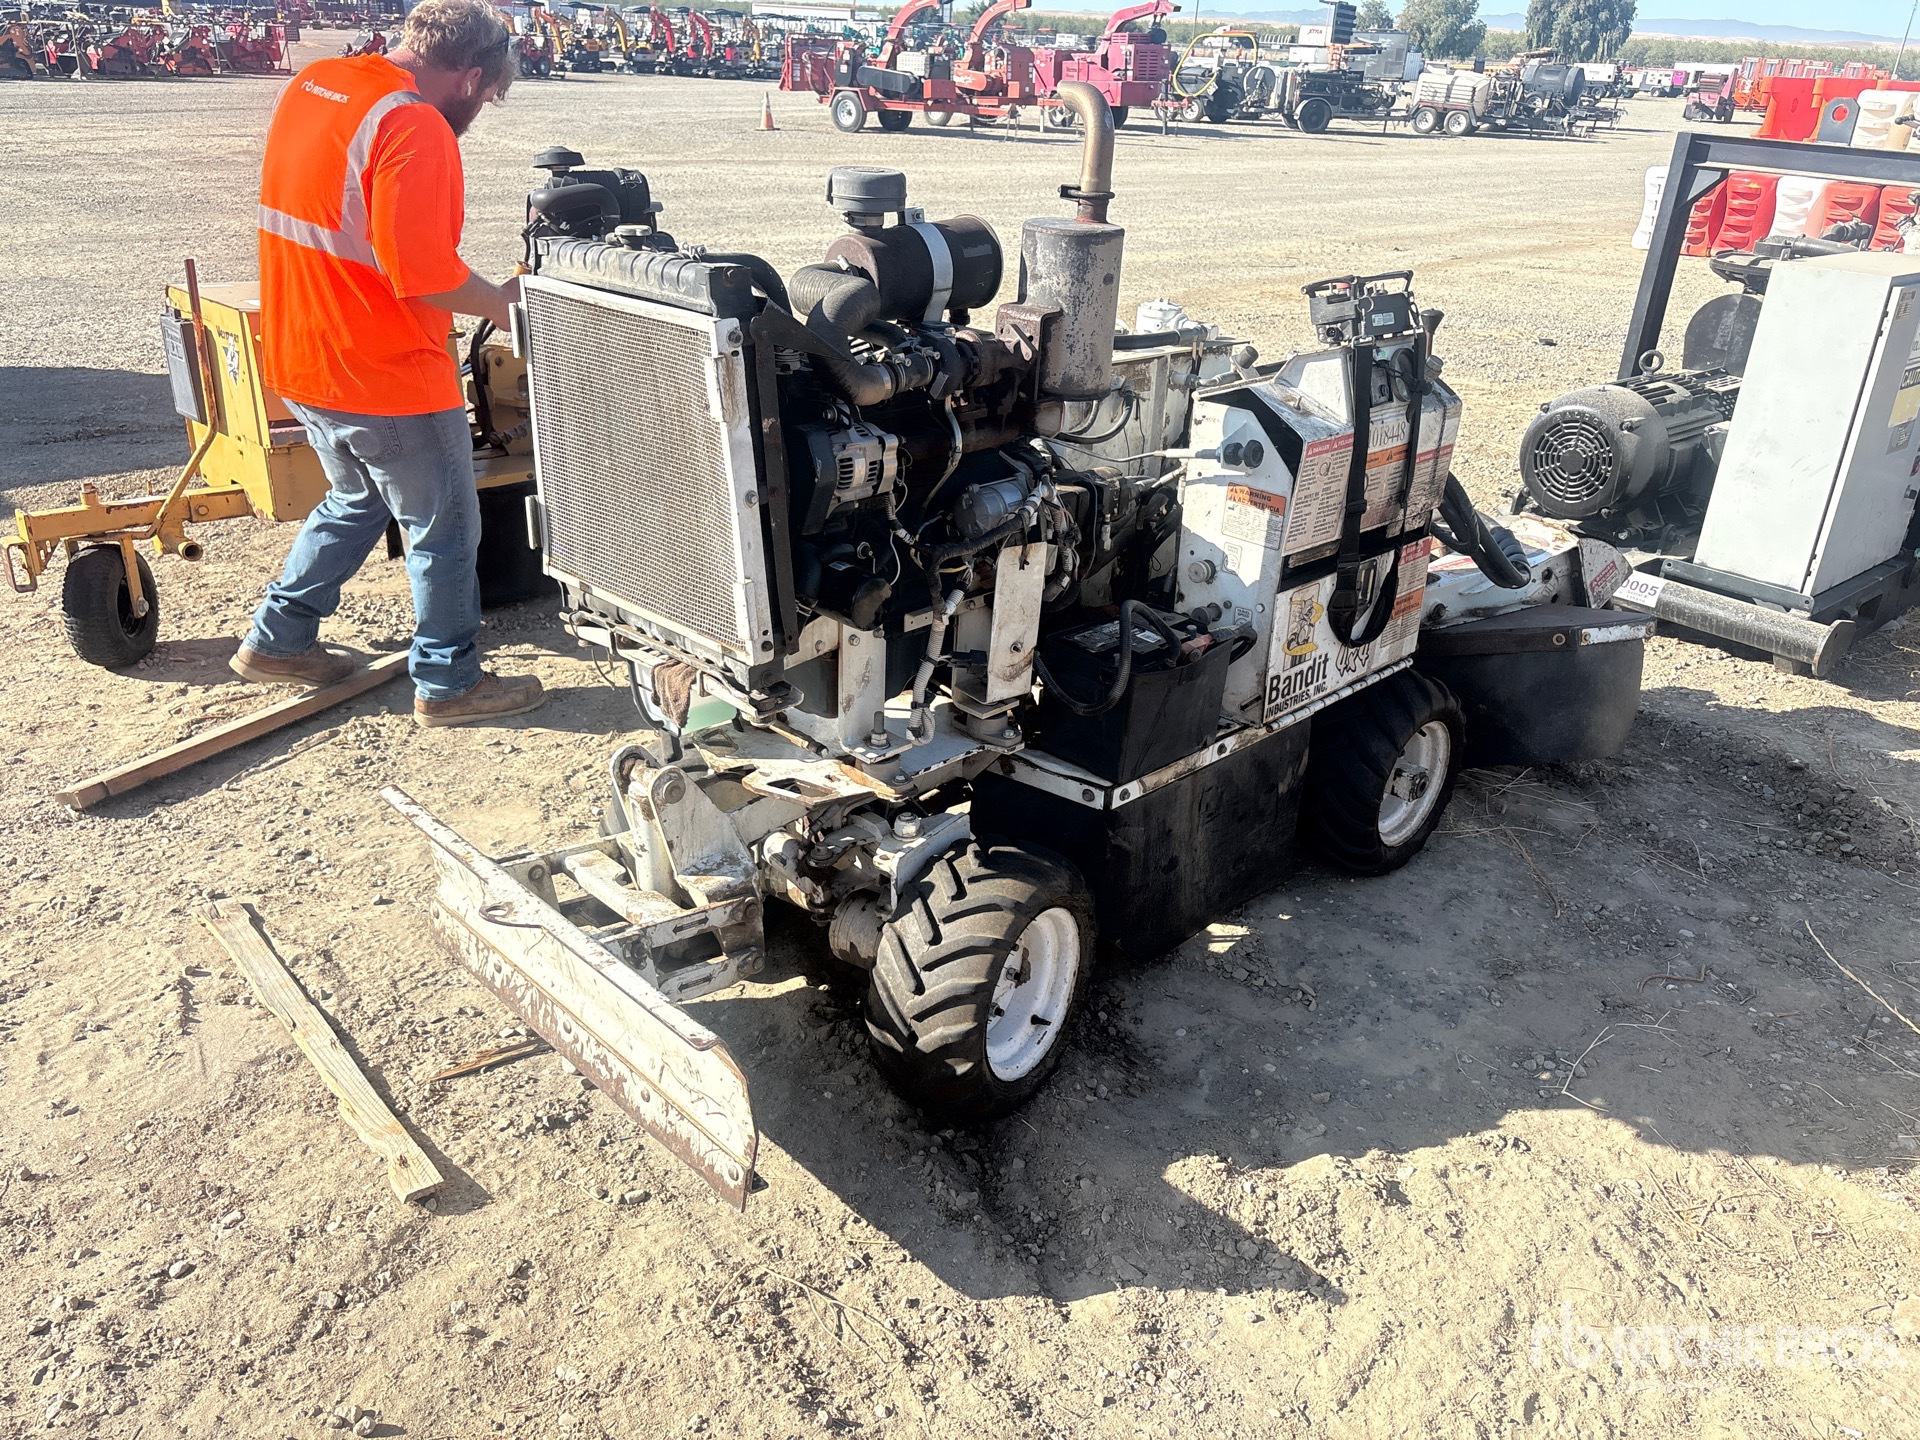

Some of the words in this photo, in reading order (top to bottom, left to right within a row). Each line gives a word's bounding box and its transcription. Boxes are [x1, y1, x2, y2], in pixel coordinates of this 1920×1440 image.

[1553, 411, 1607, 431] BALDOR
[1238, 496, 1280, 514] ADVERTENCIA
[1239, 488, 1272, 502] WARNING
[1267, 653, 1330, 706] Bandit
[1265, 688, 1312, 719] INDUSTRIES,
[1313, 681, 1328, 696] INC.
